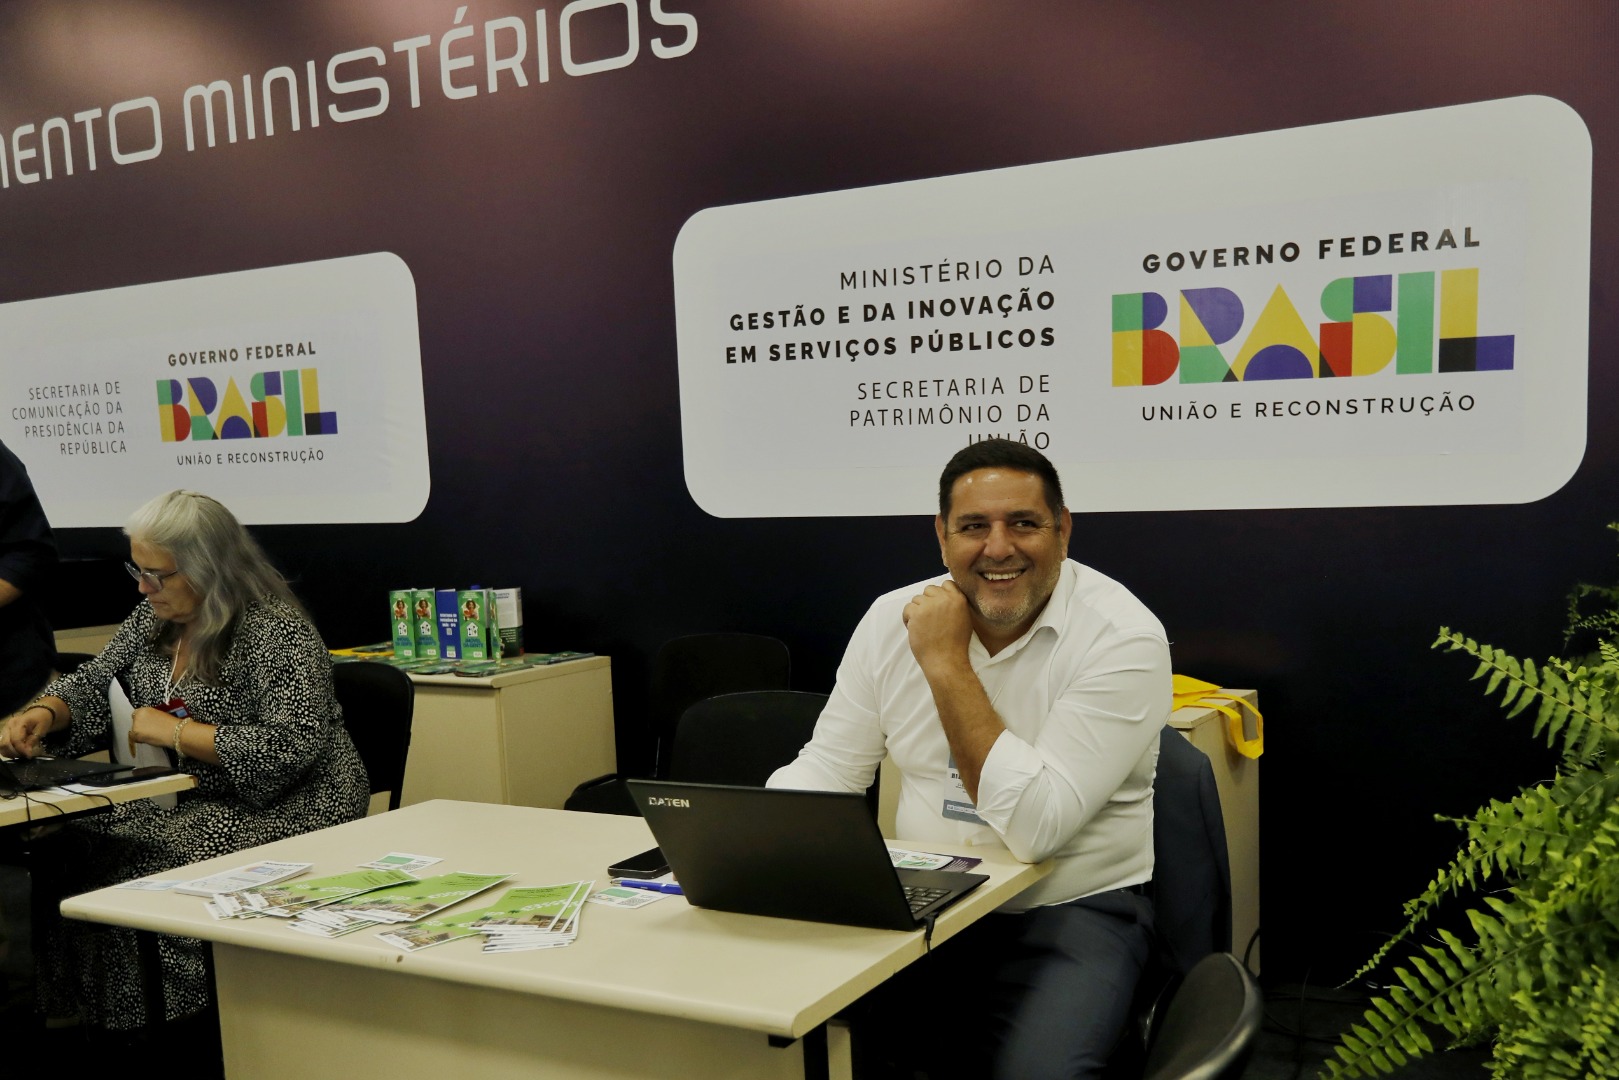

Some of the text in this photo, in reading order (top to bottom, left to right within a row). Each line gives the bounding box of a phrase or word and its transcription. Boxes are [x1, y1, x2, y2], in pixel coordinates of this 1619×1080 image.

[183, 0, 698, 152] MINISTÉRIOS
[1143, 227, 1479, 273] GOVERNO FEDERAL
[841, 255, 1054, 290] MINISTÉRIO DA
[730, 287, 1054, 331] GESTÃO E DA INOVAÇÃO
[1112, 268, 1515, 387] BRASIL
[168, 342, 316, 366] GOVERNO FEDERAL
[726, 327, 1054, 364] EM SERVIÇOS PÚBLICOS
[29, 381, 120, 400] SECRETARIA DE
[858, 375, 1049, 400] SECRETARIA DE
[12, 401, 122, 420] COMUNICAÇÃO DA
[156, 368, 338, 442] BRASIL
[851, 404, 1049, 426] PATRIMÔNIO DA
[1143, 392, 1474, 421] UNIÃO E RECONSTRUÇÃO
[25, 421, 124, 437] PRESIDÊNCIA DA
[60, 441, 126, 455] REPÚBLICA
[177, 450, 323, 465] UNIÃO E RECONSTRUÇÃO
[649, 797, 690, 808] DATEN
